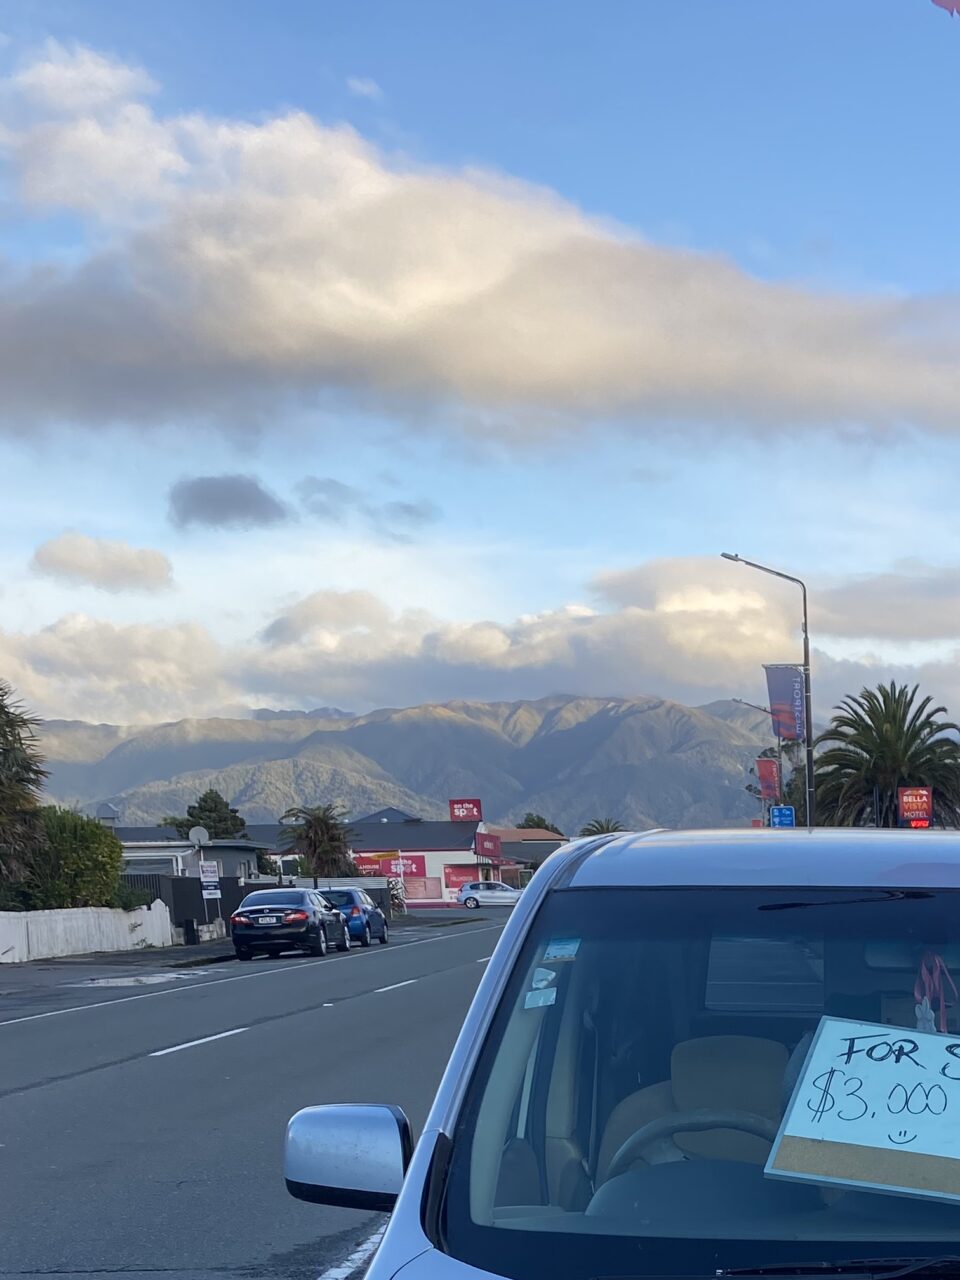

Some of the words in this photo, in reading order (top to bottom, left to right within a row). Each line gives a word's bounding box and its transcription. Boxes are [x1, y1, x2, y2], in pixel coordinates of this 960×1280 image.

[904, 802, 929, 810] VISTA
[454, 807, 478, 817] spot
[837, 1033, 927, 1069] FOR
